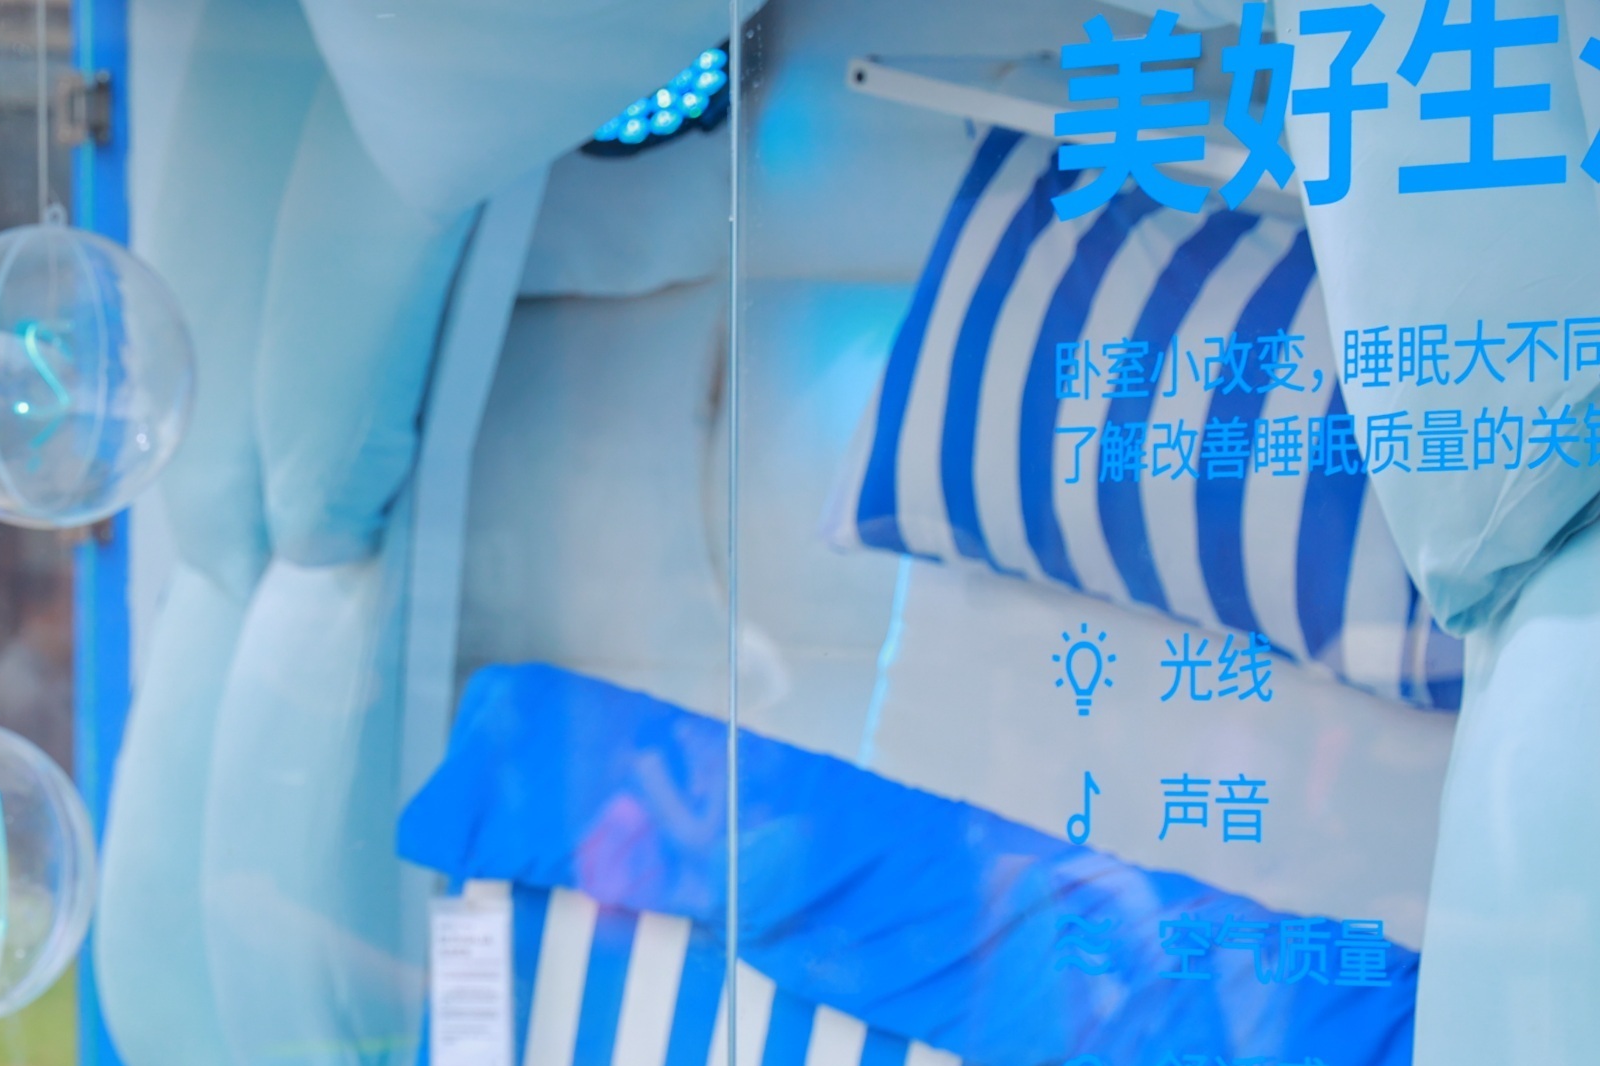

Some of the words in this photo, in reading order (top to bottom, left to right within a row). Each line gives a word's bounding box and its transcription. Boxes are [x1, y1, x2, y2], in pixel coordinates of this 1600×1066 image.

[1050, 0, 1600, 222] 美好生
[1053, 403, 1600, 485] 了解改善睡眠质量的关
[1160, 631, 1273, 702] 光线
[1158, 772, 1269, 844] 声音
[1158, 912, 1393, 987] 空气质量
